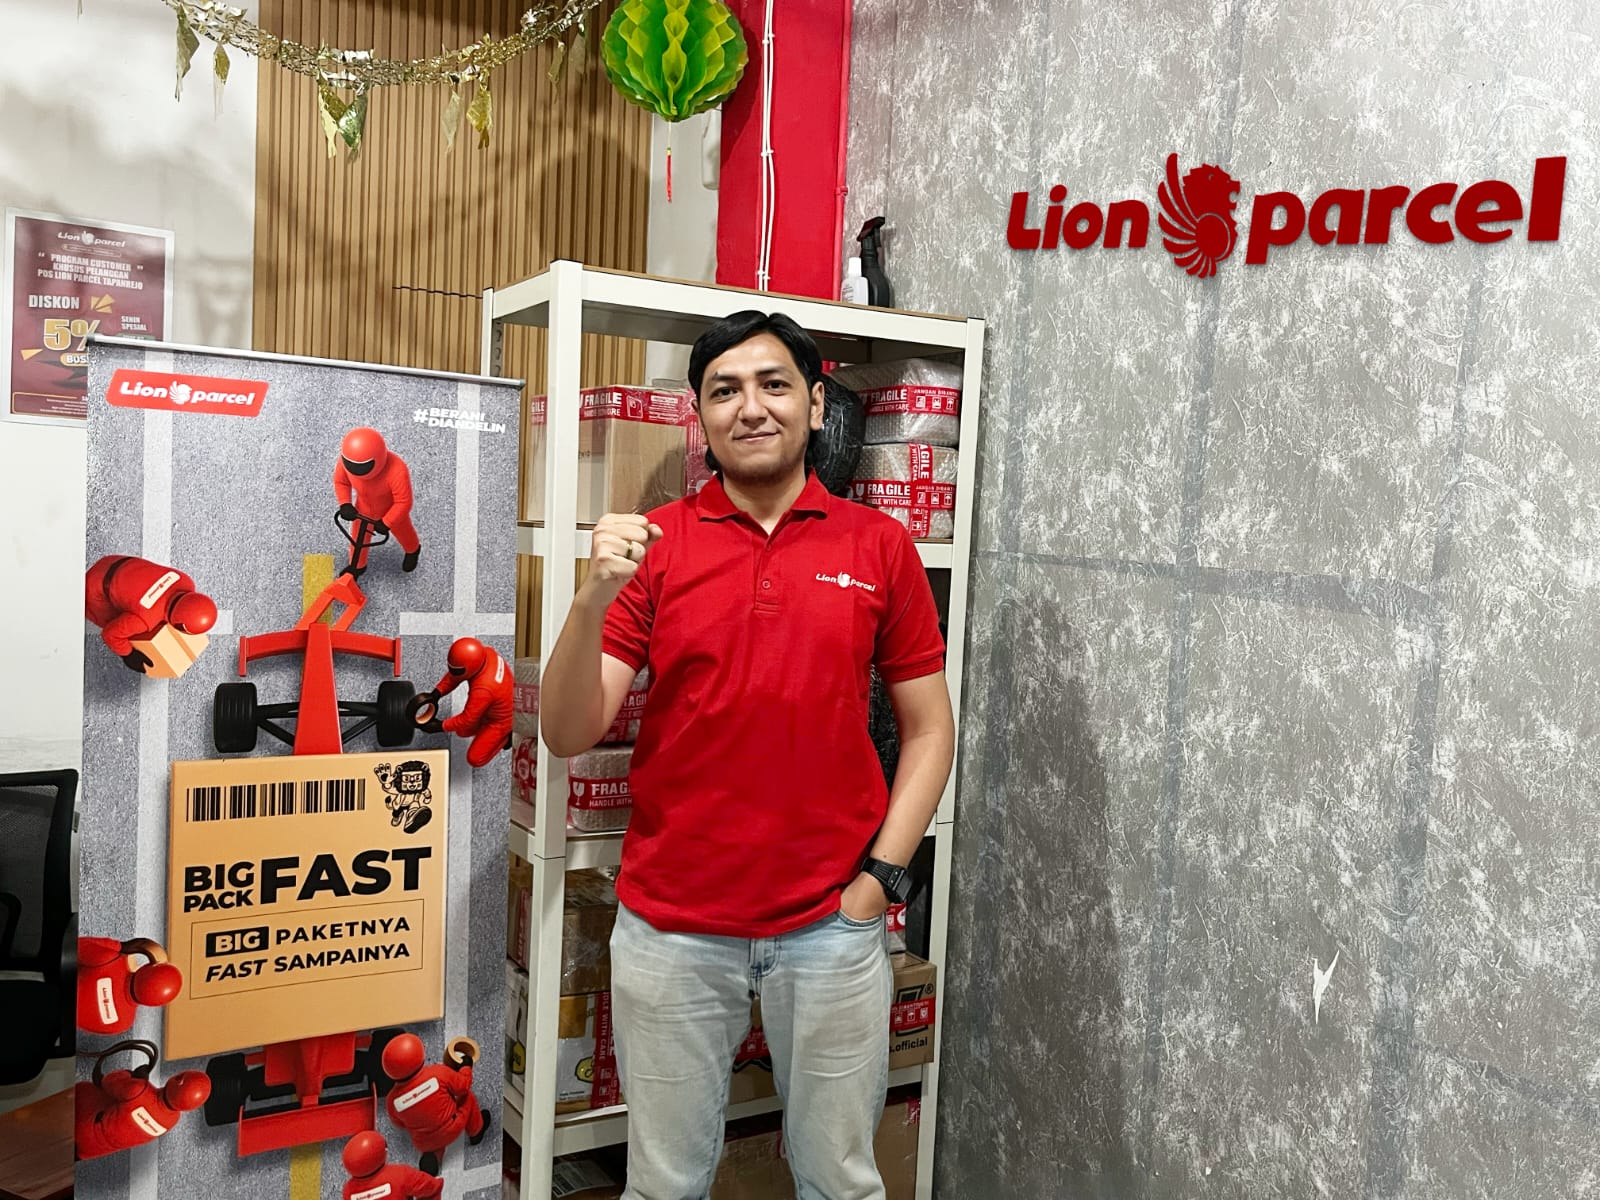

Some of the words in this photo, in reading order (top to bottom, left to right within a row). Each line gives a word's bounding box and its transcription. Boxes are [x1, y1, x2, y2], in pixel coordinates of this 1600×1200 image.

[1006, 184, 1149, 250] Lion
[1245, 156, 1567, 265] parcel
[57, 231, 80, 241] Lion
[94, 238, 126, 248] parcel
[50, 253, 89, 266] PROGRAM
[90, 258, 132, 272] CUSTOMER
[53, 262, 85, 274] KHUSUS
[86, 266, 129, 280] PELANGGAN
[37, 268, 54, 279] POS
[54, 270, 72, 281] LION
[73, 272, 101, 285] PARCEL
[28, 294, 80, 310] DISKON
[43, 318, 100, 351] 5%
[66, 355, 89, 364] BOS
[119, 381, 168, 398] Lion
[191, 390, 256, 405] parcel
[585, 392, 622, 406] FRAGILE
[871, 389, 908, 402] FRAGILE
[531, 401, 545, 412] GILE
[413, 408, 486, 423] #BERANI
[920, 444, 930, 479] AGILE
[867, 484, 911, 496] FRAGILE
[815, 573, 837, 583] Lion
[850, 578, 877, 592] parcel
[591, 782, 629, 796] FRAG
[589, 799, 615, 807] HANDLE
[184, 861, 255, 893] BIG
[260, 846, 432, 905] FAST
[183, 889, 254, 913] PACK
[214, 930, 262, 954] BIG
[275, 917, 411, 945] PAKETNYA
[206, 959, 268, 983] FAST
[274, 942, 410, 973] SAMPAINYA
[889, 1037, 929, 1053] .official
